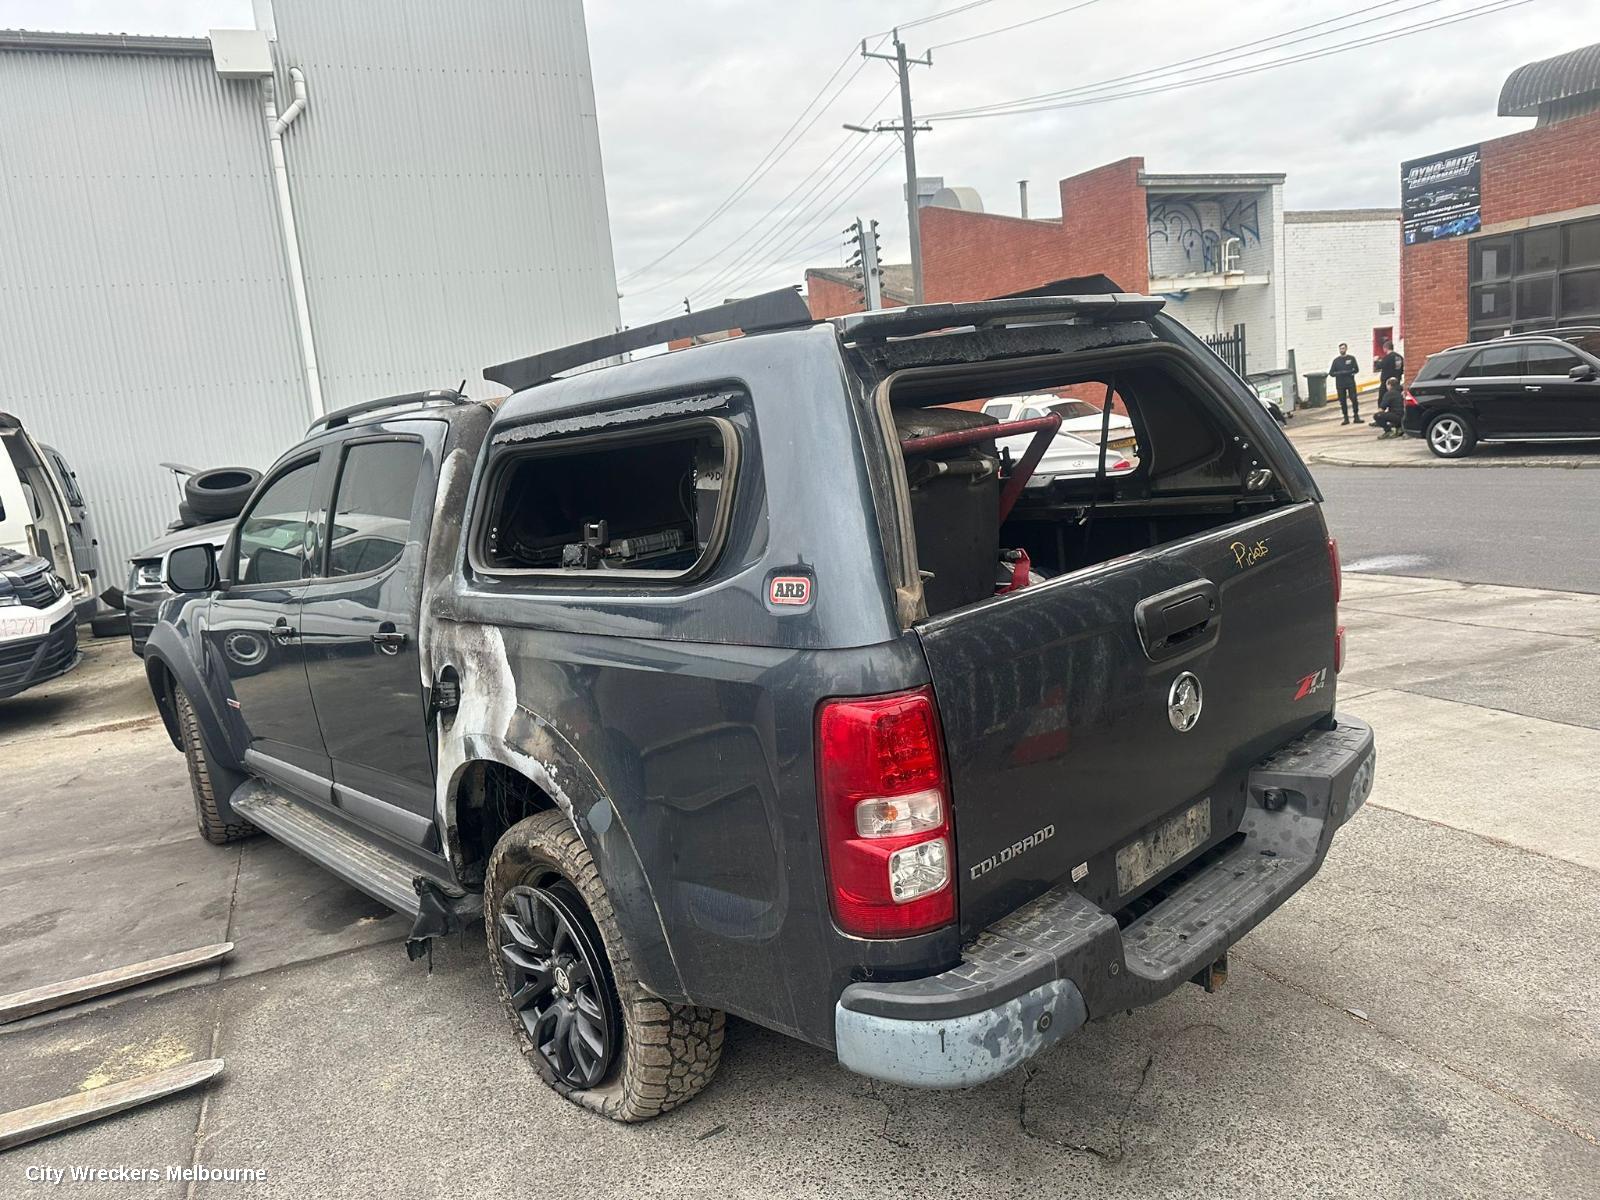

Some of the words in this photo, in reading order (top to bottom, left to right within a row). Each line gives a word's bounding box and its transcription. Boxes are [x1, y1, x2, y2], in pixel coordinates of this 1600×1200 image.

[774, 582, 805, 598] ARB
[1294, 667, 1327, 701] Z71
[970, 824, 1055, 880] COLORADO
